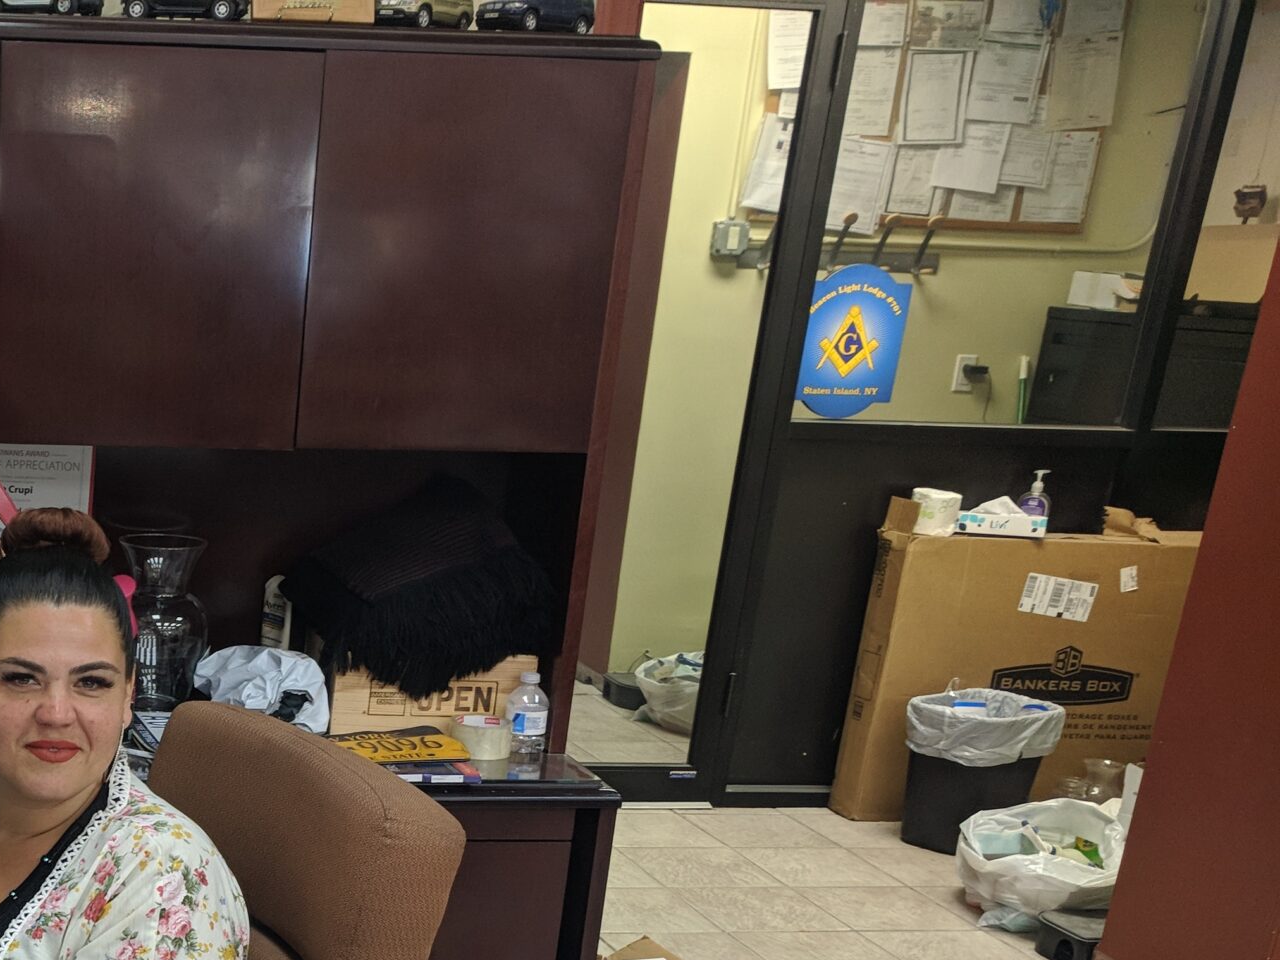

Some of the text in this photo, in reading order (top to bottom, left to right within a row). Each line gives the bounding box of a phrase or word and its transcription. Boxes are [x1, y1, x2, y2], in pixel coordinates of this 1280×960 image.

[838, 284, 861, 294] Light
[862, 284, 888, 299] Lodge
[885, 297, 902, 316] #701
[838, 333, 858, 356] G
[803, 386, 830, 395] Staten
[863, 387, 880, 396] NY
[6, 460, 80, 473] APPRECIATION
[8, 485, 34, 495] Crupi
[1000, 678, 1122, 694] BANKERS BOX
[417, 686, 493, 713] OPEN
[358, 736, 443, 754] 9096
